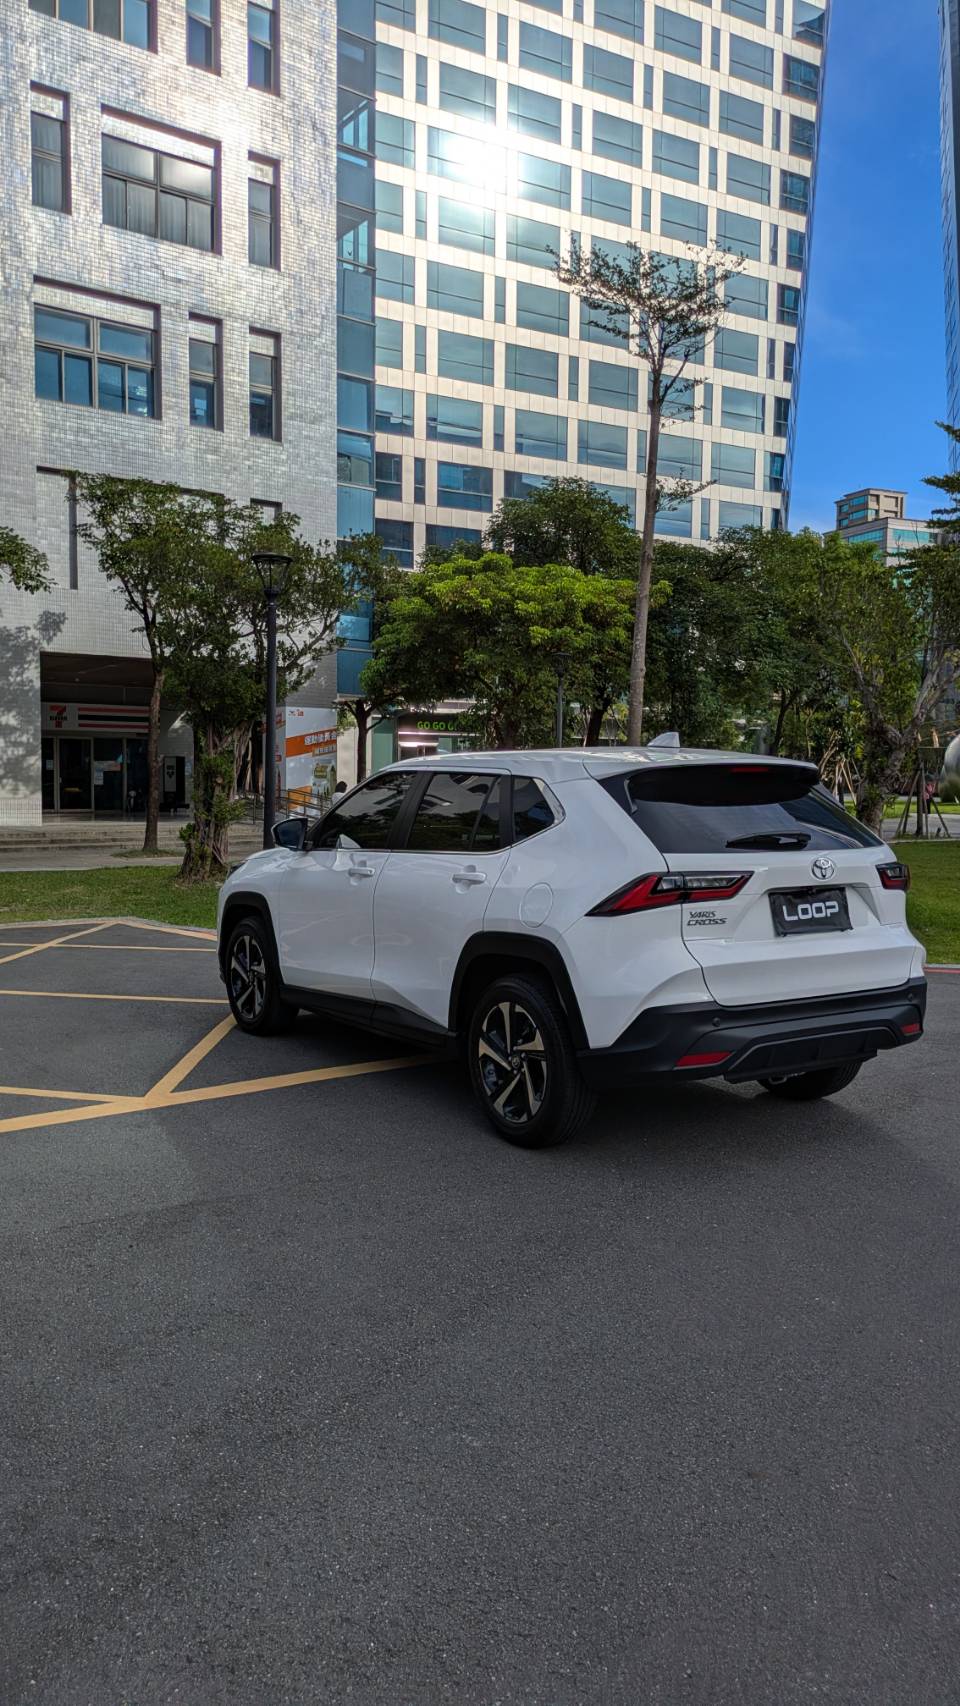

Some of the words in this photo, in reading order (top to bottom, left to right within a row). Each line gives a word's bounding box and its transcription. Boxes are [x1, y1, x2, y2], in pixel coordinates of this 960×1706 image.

[417, 721, 431, 729] GO
[432, 721, 446, 730] GO
[783, 901, 839, 921] LOOP
[687, 918, 727, 926] CROSS
